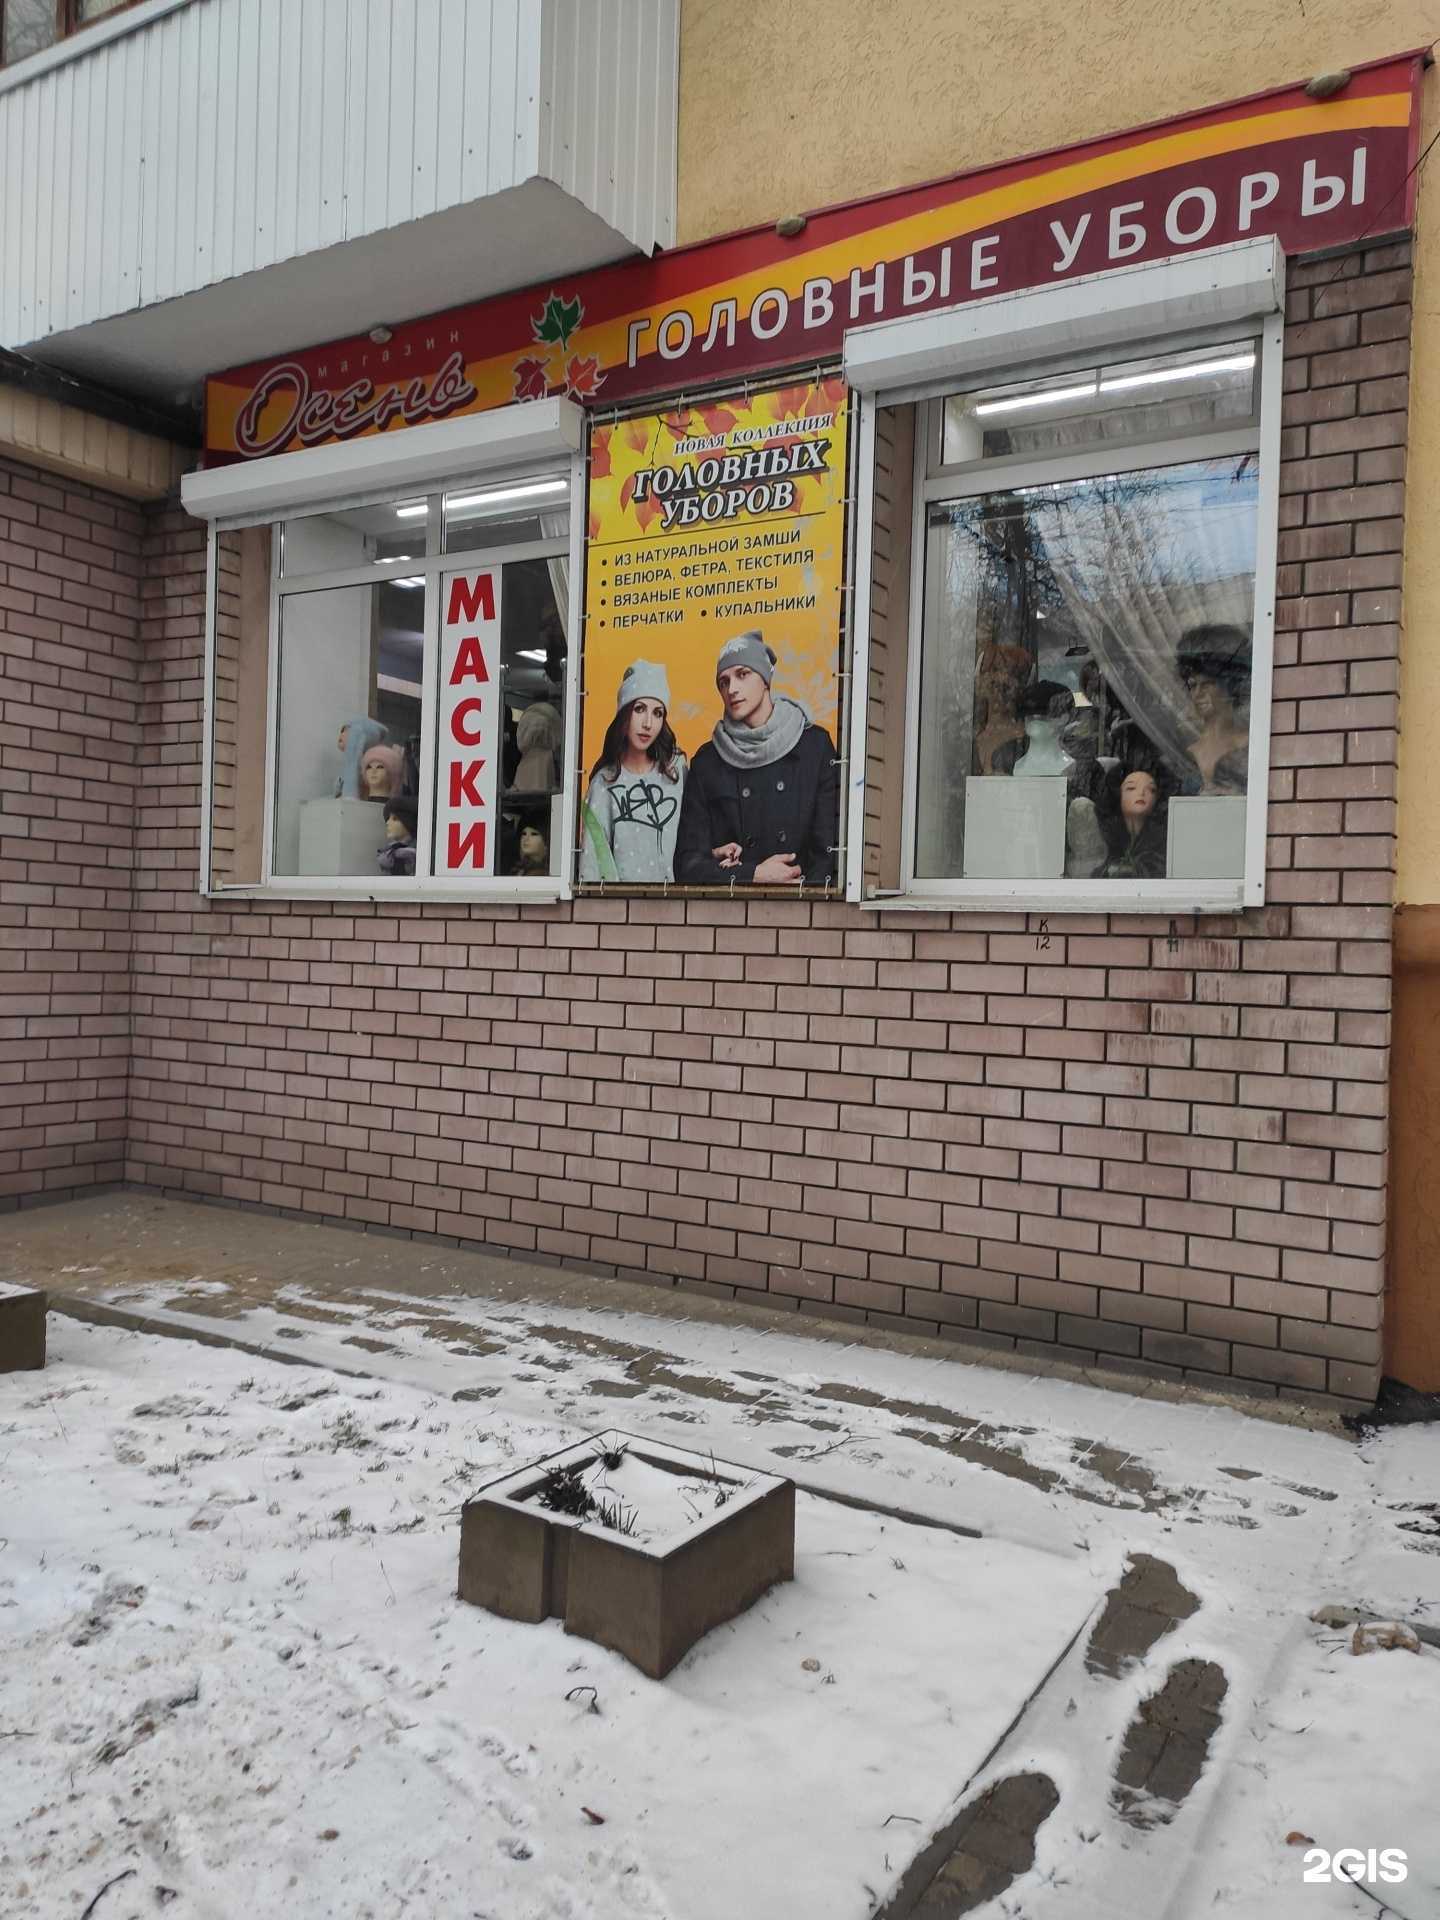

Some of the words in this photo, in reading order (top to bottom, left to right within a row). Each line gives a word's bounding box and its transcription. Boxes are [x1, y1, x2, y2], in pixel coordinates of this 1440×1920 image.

[627, 233, 1001, 369] ГОЛОВНЫЕ
[1049, 147, 1368, 273] УБОРЫ
[233, 352, 478, 458] Осень
[673, 433, 727, 456] НОВАЯ
[732, 414, 833, 445] КОЛЛЕКЦИЯ
[632, 439, 832, 503] ГОЛОВНЫХ
[660, 481, 796, 531] УБОРОВ
[614, 555, 632, 567] ИЗ
[635, 536, 739, 565] НАТУРАЛЬНОЙ
[743, 529, 801, 551] ЗАМШИ
[614, 570, 676, 587] ВЕЛЮРА,
[680, 562, 732, 580] ФЕТРА,
[736, 550, 815, 571] ТЕКСТИЛЯ
[612, 610, 685, 629] ПЕРЧАТКИ
[714, 595, 816, 619] КУПАЛЬНИКИ
[613, 588, 681, 607] ВЯЗАНЫЕ
[685, 576, 779, 598] КОМПЛЕКТЫ
[446, 573, 497, 869] МАСКИ
